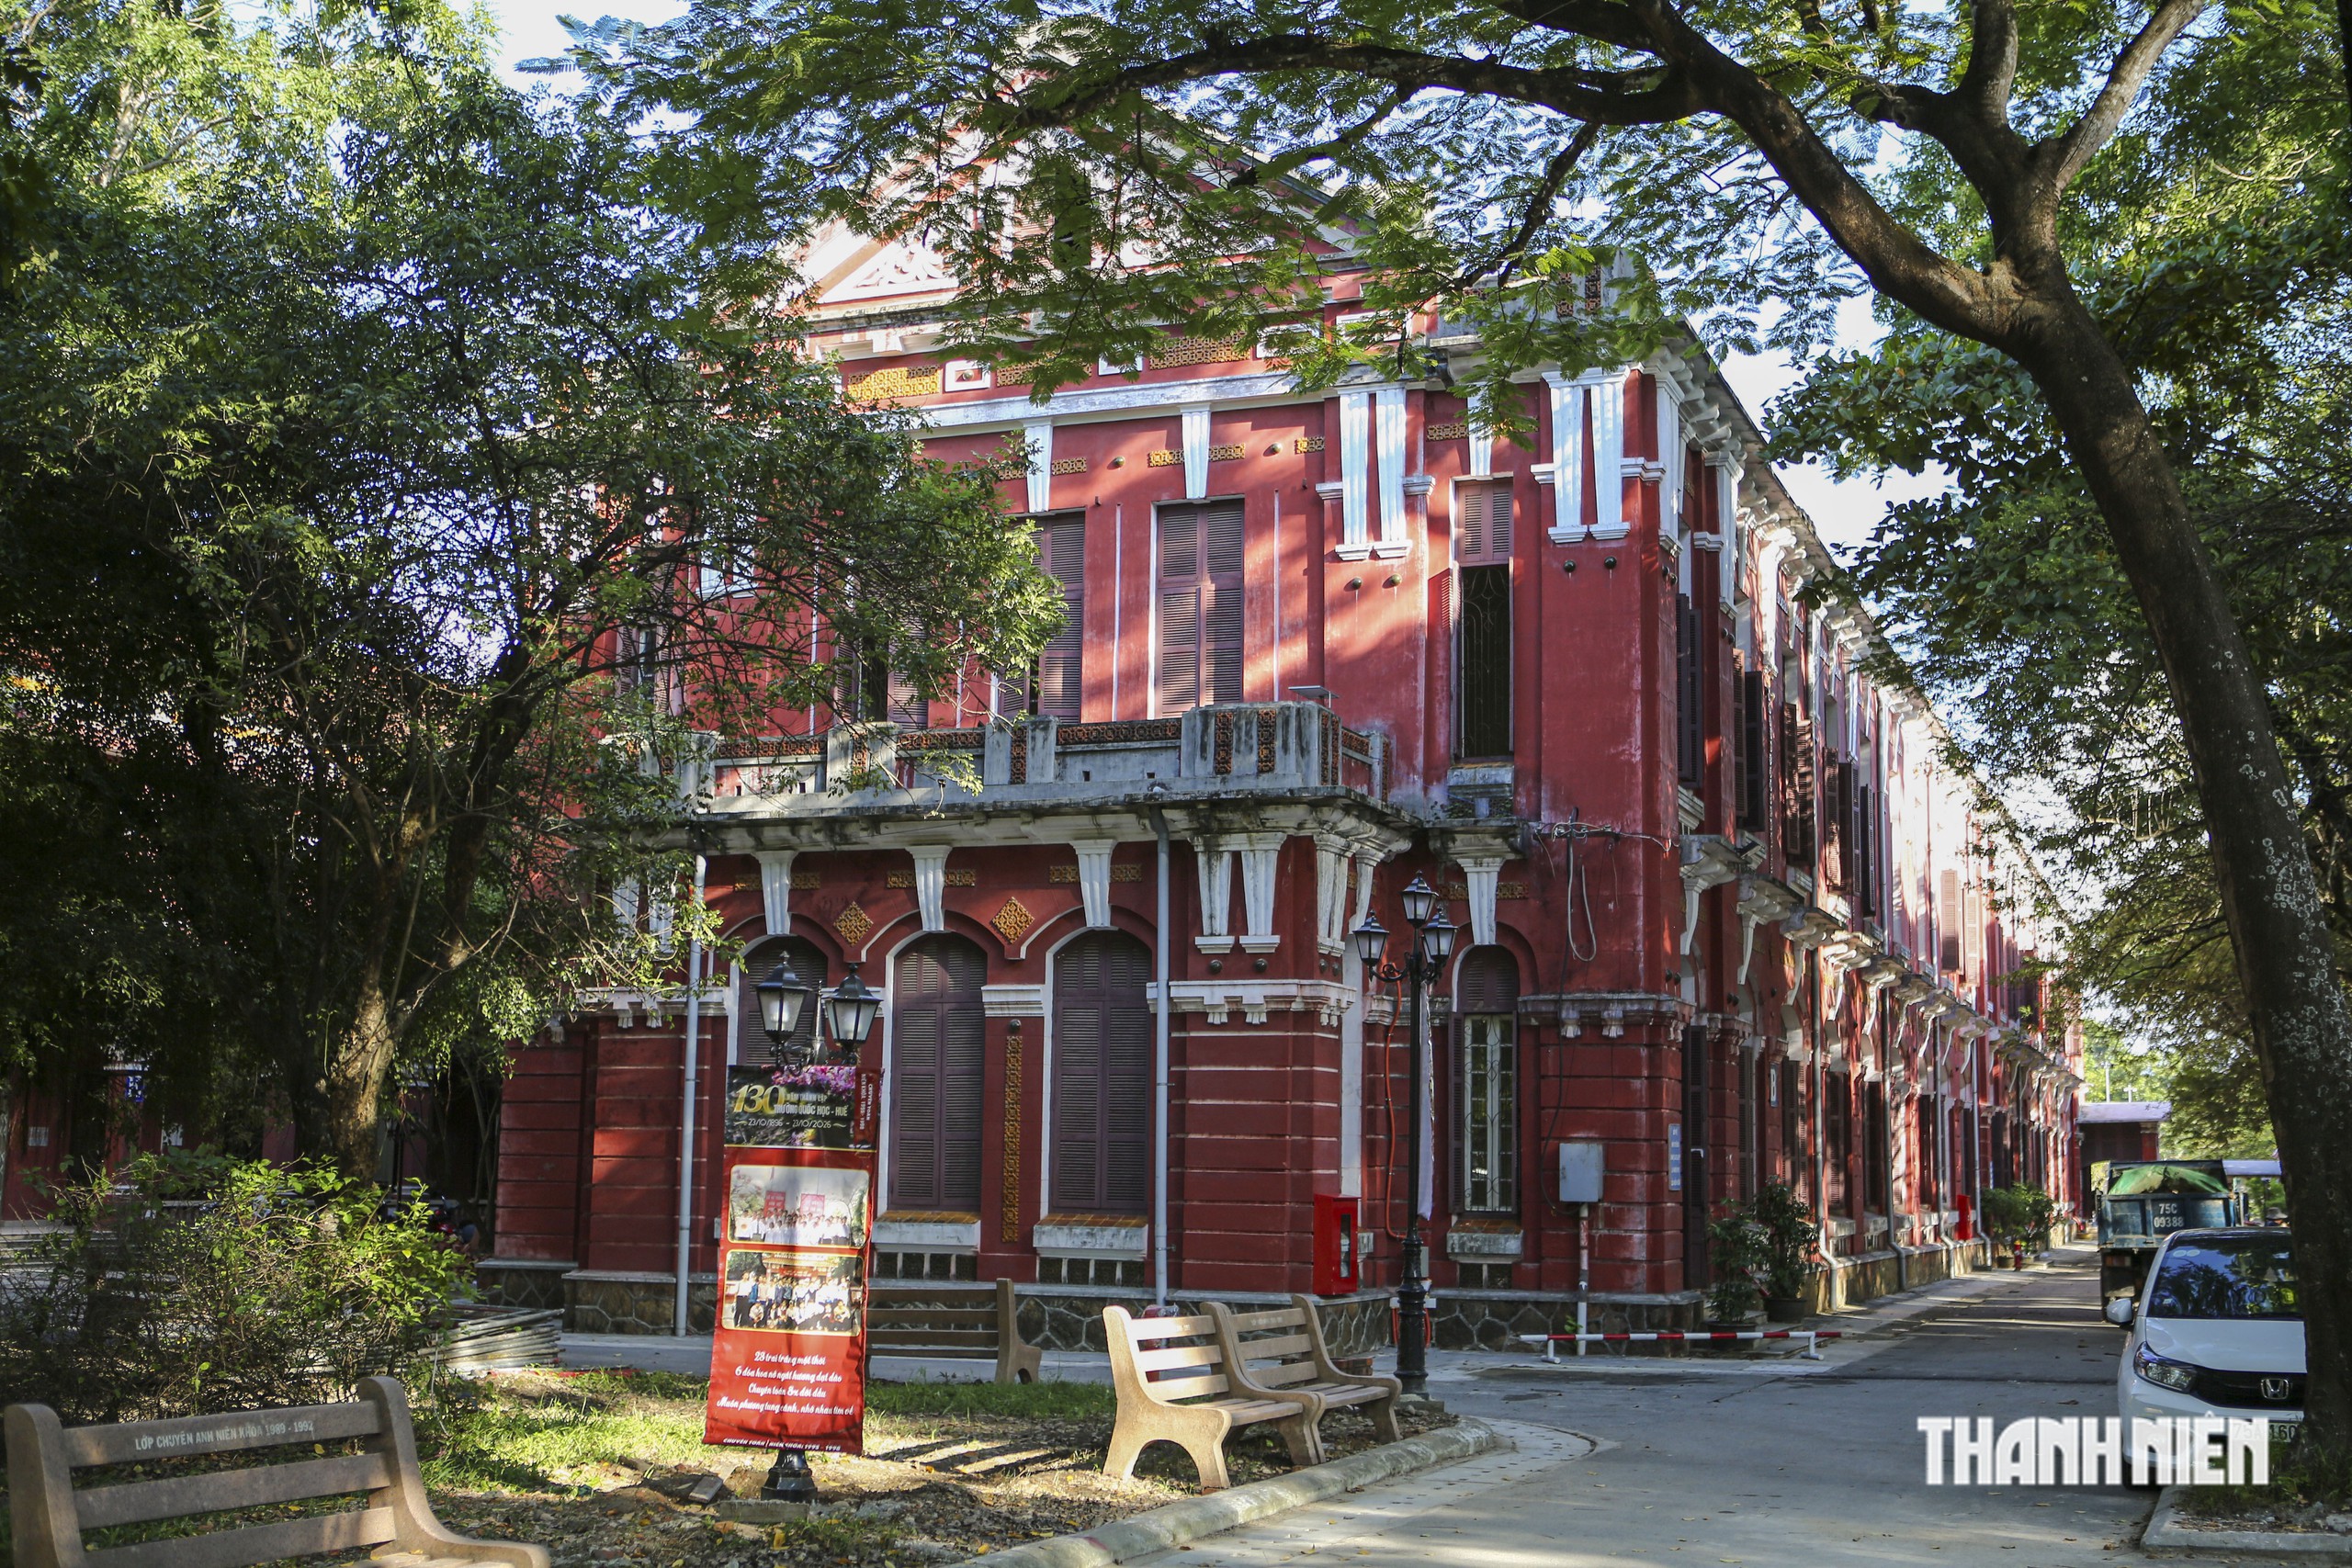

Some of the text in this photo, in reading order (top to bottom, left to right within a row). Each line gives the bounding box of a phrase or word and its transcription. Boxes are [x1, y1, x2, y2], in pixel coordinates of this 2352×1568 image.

[733, 1085, 785, 1114] 130
[775, 1102, 797, 1114] TRƯỜNG
[798, 1102, 816, 1115] QUỐC
[817, 1105, 830, 1117] HỌC
[835, 1104, 849, 1117] HUẾ
[748, 1118, 783, 1127] 23/10/1896
[792, 1119, 831, 1129] 23/10/2026
[2158, 1202, 2177, 1214] 75C
[2154, 1216, 2185, 1228] 09388
[754, 1350, 765, 1361] 28
[735, 1365, 742, 1376] 6
[748, 1382, 772, 1396] Chuyên
[135, 1432, 153, 1450] LỚP
[156, 1430, 194, 1448] CHUYÊN
[195, 1431, 214, 1443] ANH
[216, 1426, 237, 1441] NIÊN
[266, 1423, 286, 1437] 1989
[294, 1420, 313, 1433] 1992
